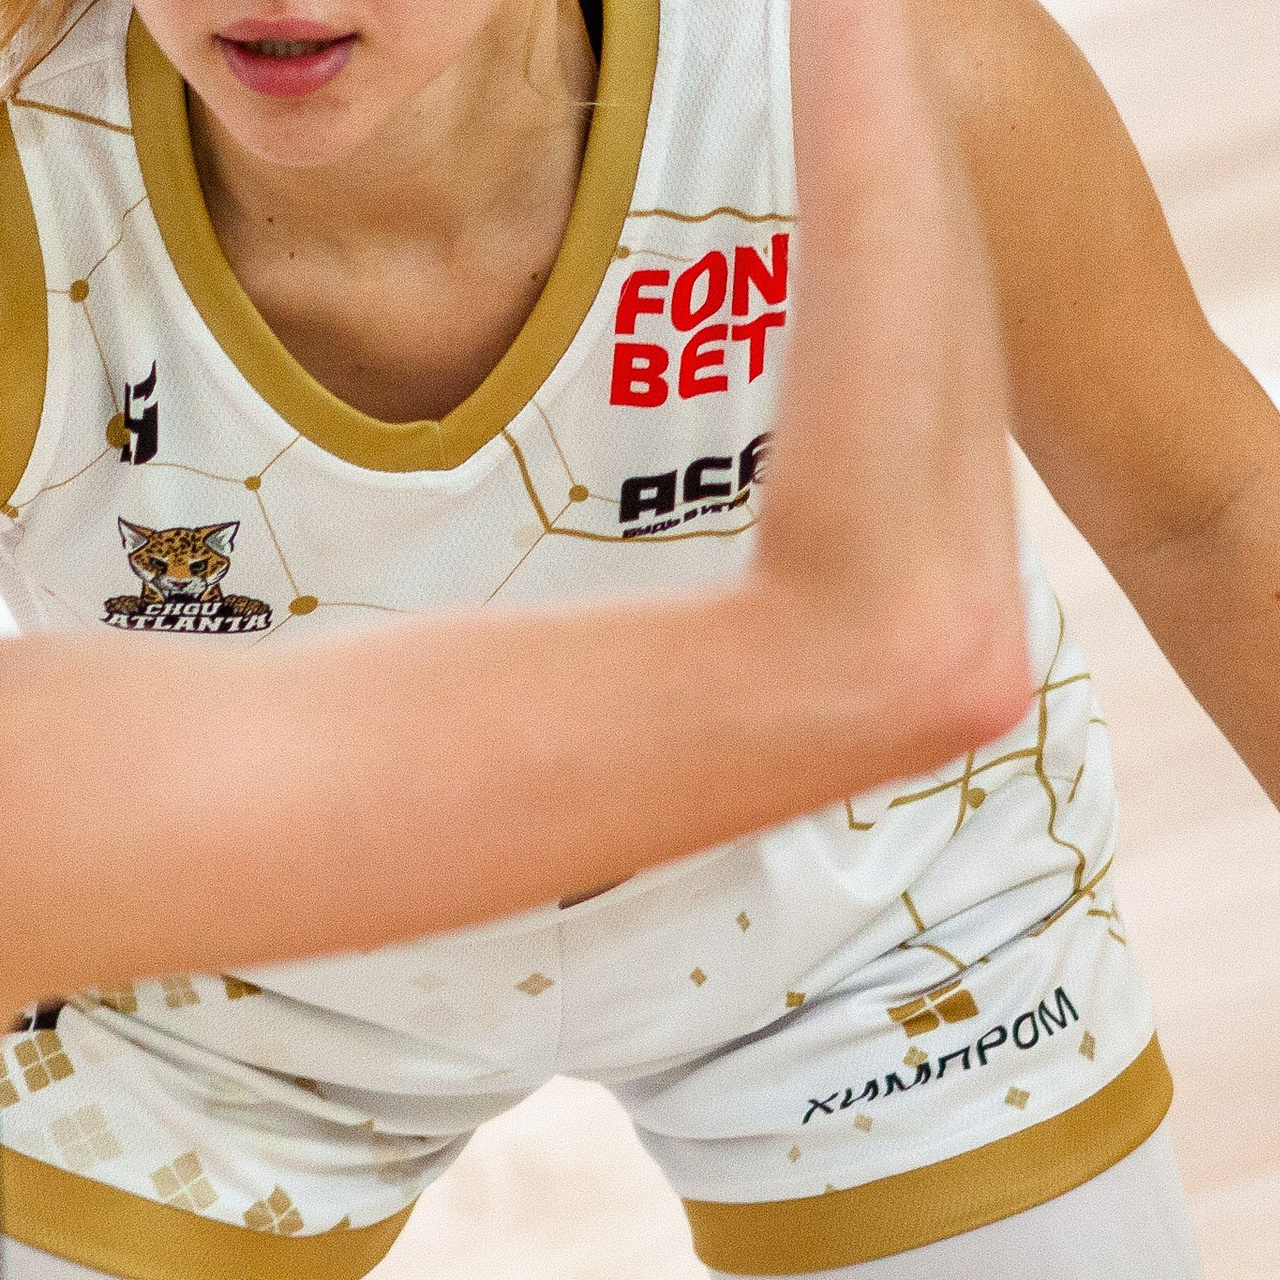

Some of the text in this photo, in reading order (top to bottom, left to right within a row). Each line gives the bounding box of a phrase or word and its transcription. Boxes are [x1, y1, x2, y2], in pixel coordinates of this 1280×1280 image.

[615, 233, 789, 332] FON
[609, 310, 786, 408] BET
[107, 610, 269, 633] ATLANTA
[145, 602, 221, 616] CHGU
[802, 985, 1080, 1125] ХИМПРОМ
